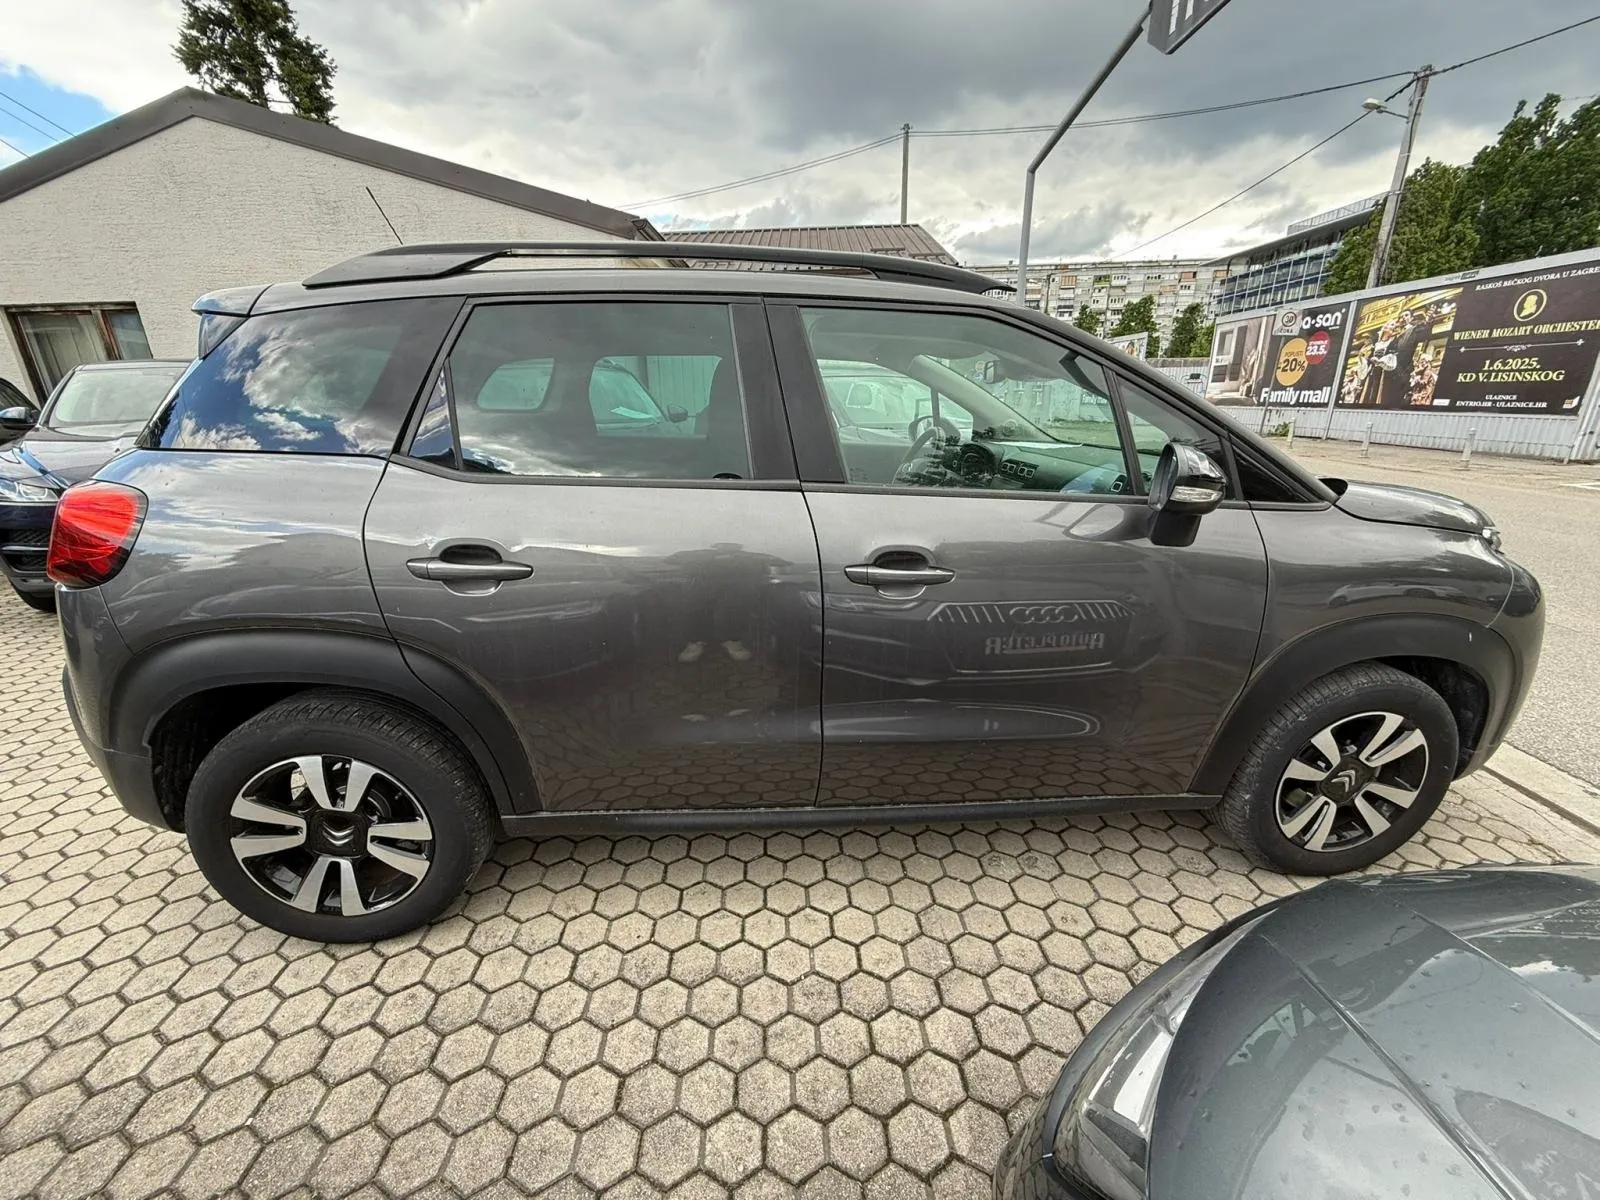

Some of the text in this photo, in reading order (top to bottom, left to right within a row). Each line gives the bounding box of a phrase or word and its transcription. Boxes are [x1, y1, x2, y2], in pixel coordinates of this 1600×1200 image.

[1533, 272, 1561, 283] DVORA
[1562, 270, 1570, 278] U
[1570, 266, 1600, 277] ZAGRE
[1285, 315, 1294, 323] 30
[1453, 328, 1490, 341] WIENER
[1490, 325, 1533, 338] MOZART
[1277, 358, 1305, 372] -20%
[1482, 357, 1541, 371] 1.6.2025.
[1456, 370, 1566, 383] KD V. LISINSKOG
[1300, 386, 1331, 403] mall
